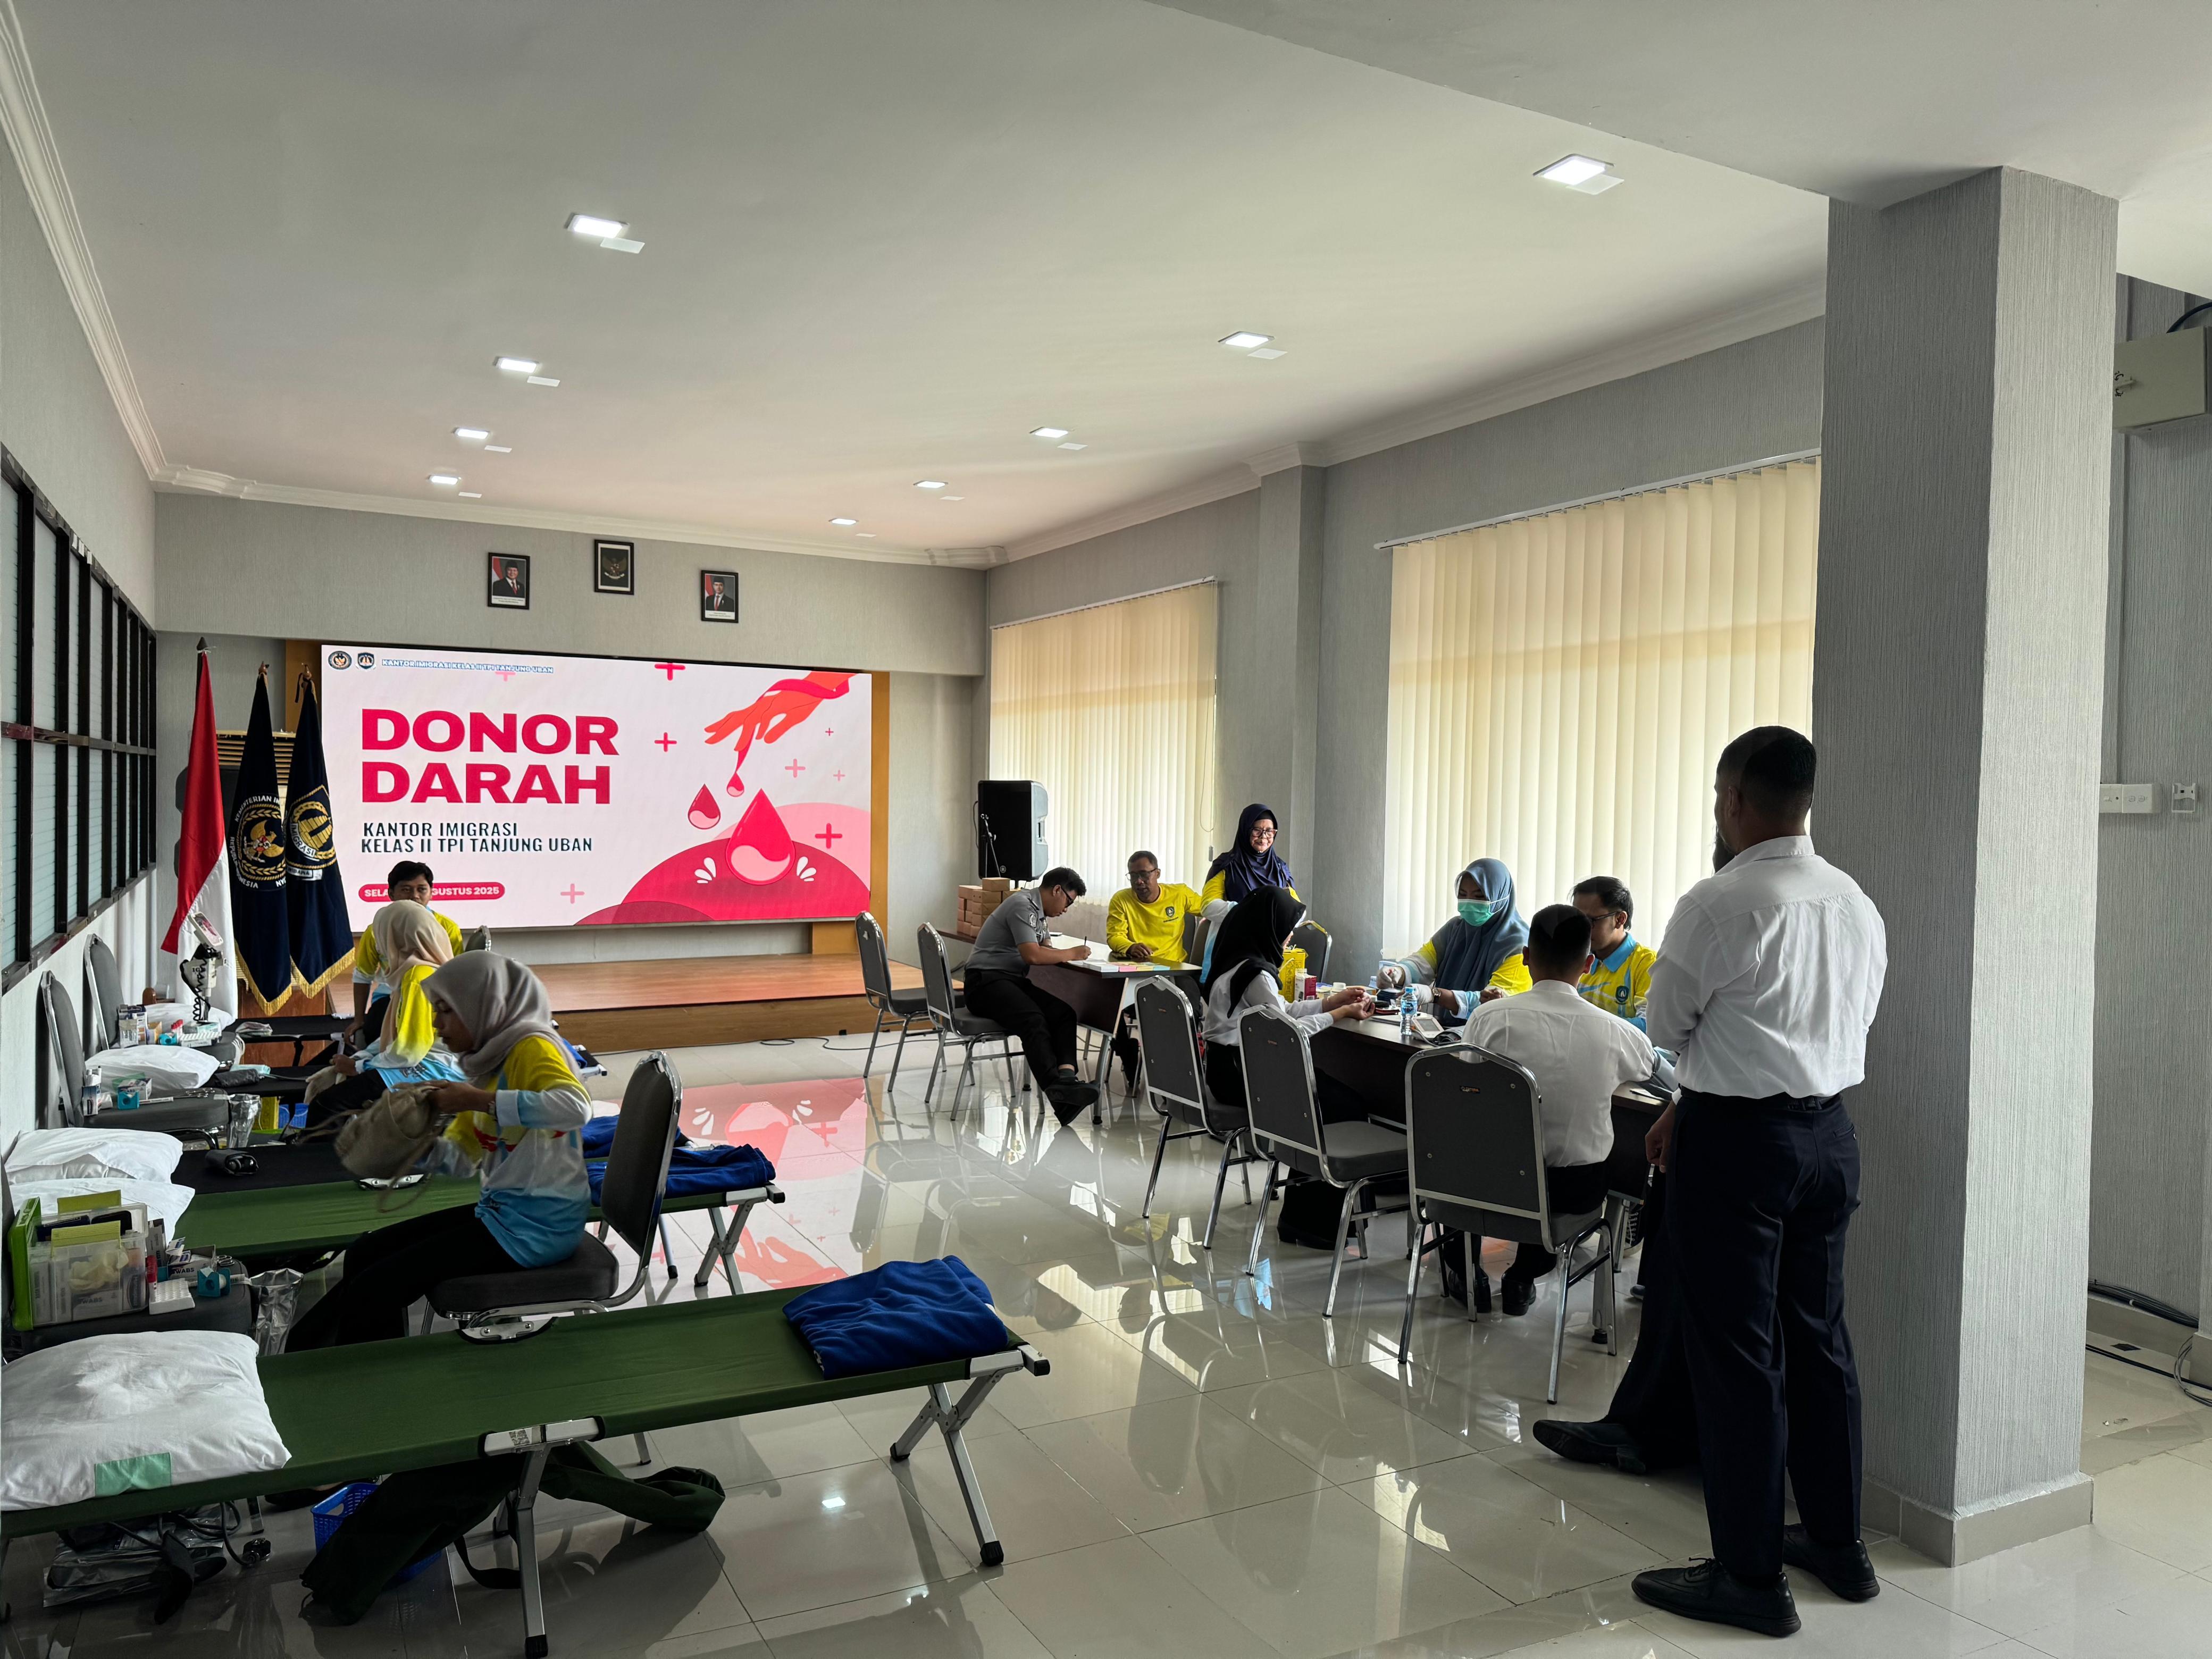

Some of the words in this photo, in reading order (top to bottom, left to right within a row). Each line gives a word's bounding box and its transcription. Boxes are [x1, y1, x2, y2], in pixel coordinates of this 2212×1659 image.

[416, 660, 451, 669] IMIGRASI
[362, 708, 619, 756] DONOR
[362, 761, 611, 804] DARAH
[234, 795, 272, 822] KEMENTERIAN
[364, 822, 432, 836] KANTOR
[440, 822, 518, 836] IMIGRASI
[291, 824, 314, 856] IMIGRASI
[361, 838, 414, 853] KELAS
[421, 839, 431, 852] II
[437, 839, 464, 852] TPI
[472, 837, 542, 852] TANJUNG
[548, 837, 592, 852] UBAN
[432, 887, 472, 895] GUSTUS
[473, 886, 500, 895] 2025
